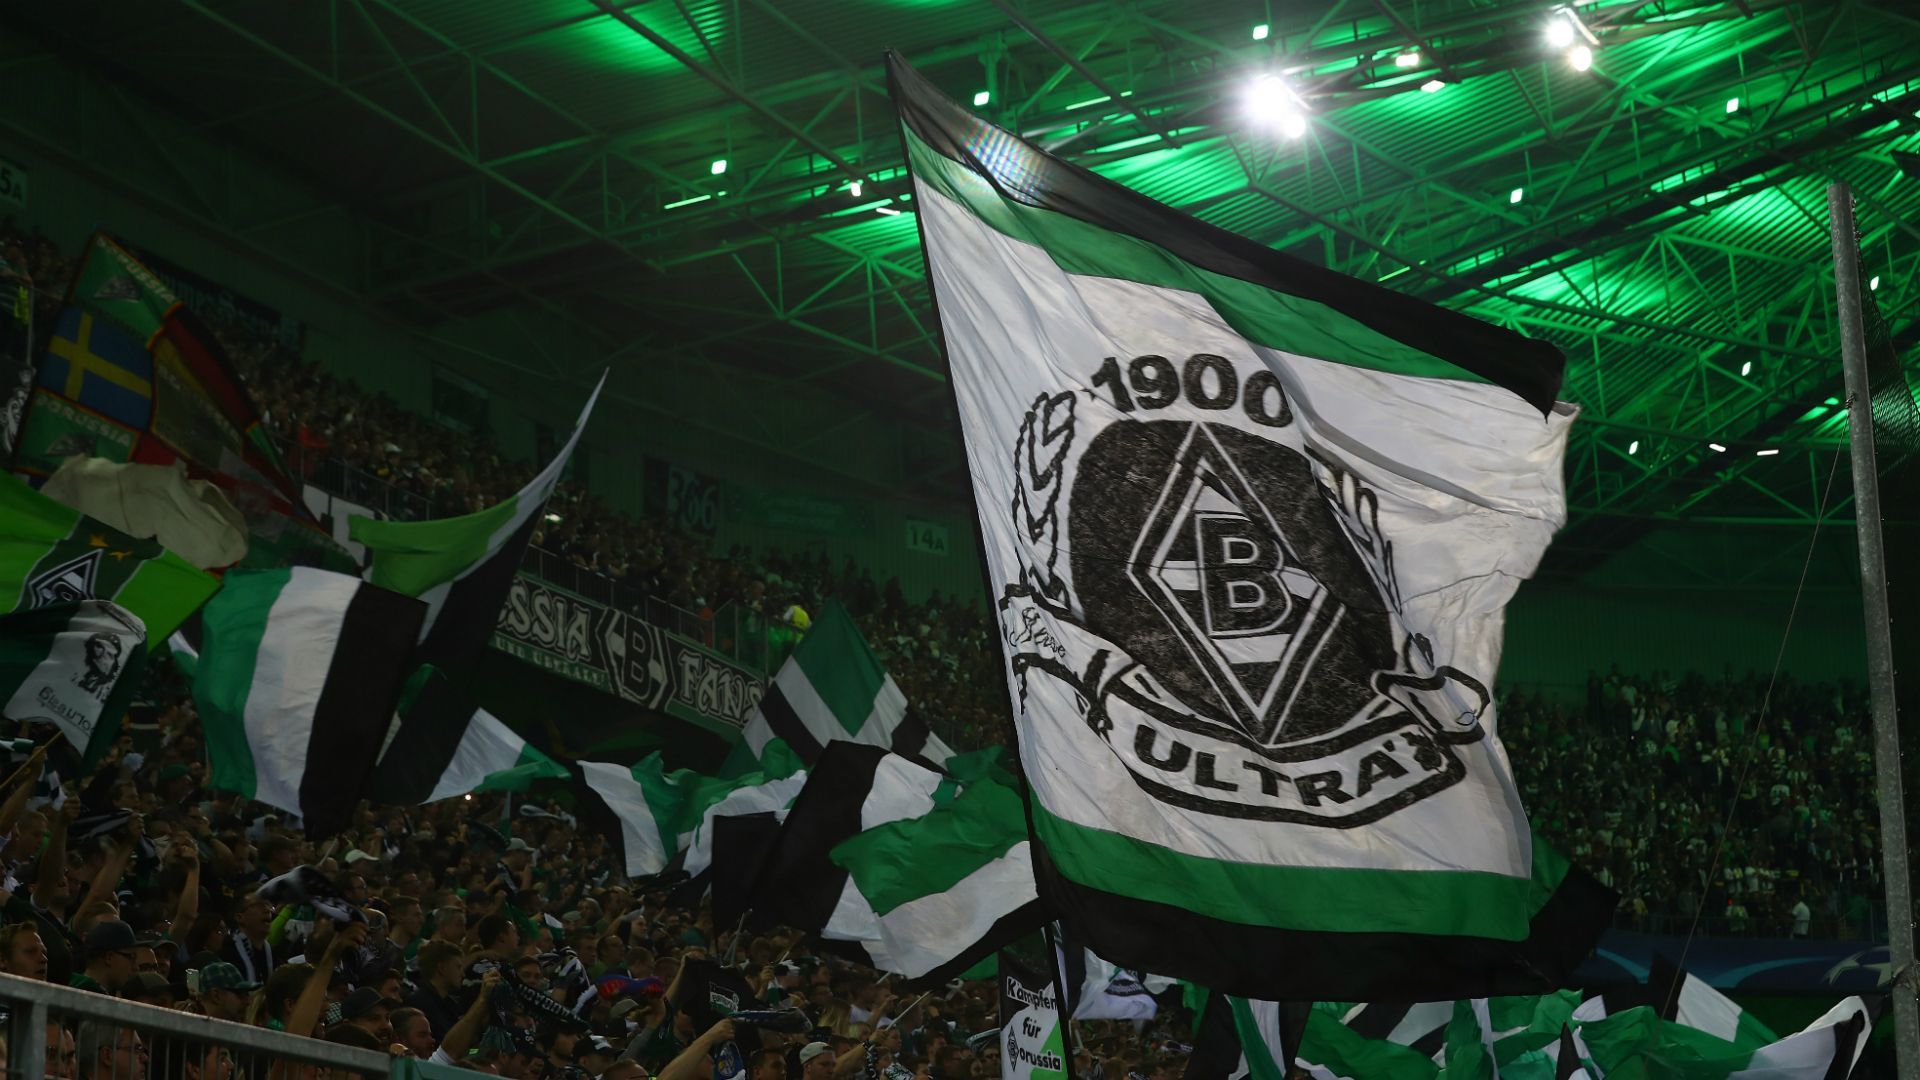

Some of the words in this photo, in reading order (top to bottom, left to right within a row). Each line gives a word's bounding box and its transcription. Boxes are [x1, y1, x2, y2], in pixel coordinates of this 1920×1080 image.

[1091, 353, 1294, 428] 1900
[909, 525, 945, 551] 14A
[1195, 512, 1293, 638] B
[1007, 978, 1057, 1010] Kämpfen
[1022, 1016, 1041, 1038] für
